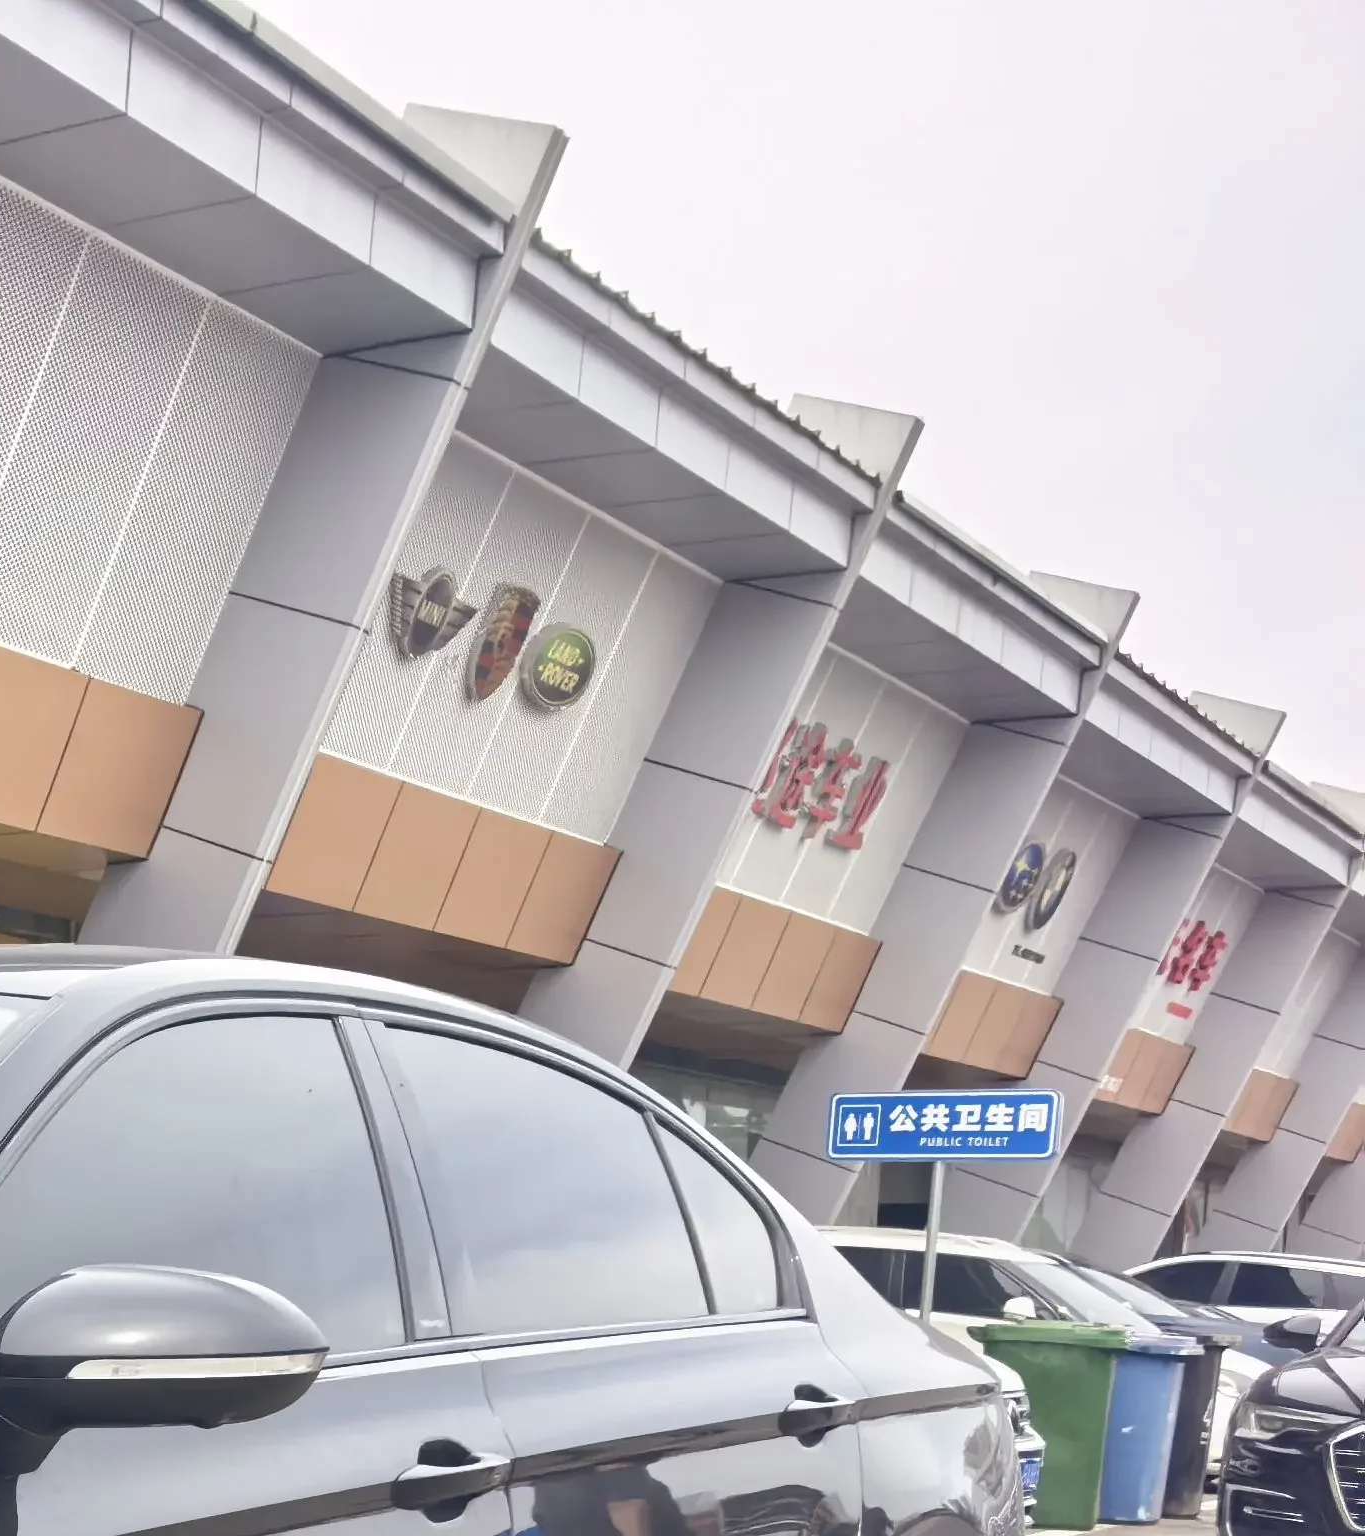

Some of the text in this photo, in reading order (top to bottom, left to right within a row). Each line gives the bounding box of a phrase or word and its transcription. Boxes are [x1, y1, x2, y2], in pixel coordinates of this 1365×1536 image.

[888, 1103, 1049, 1132] 公共卫生间
[920, 1136, 1010, 1147] PUBLIC TOILET
